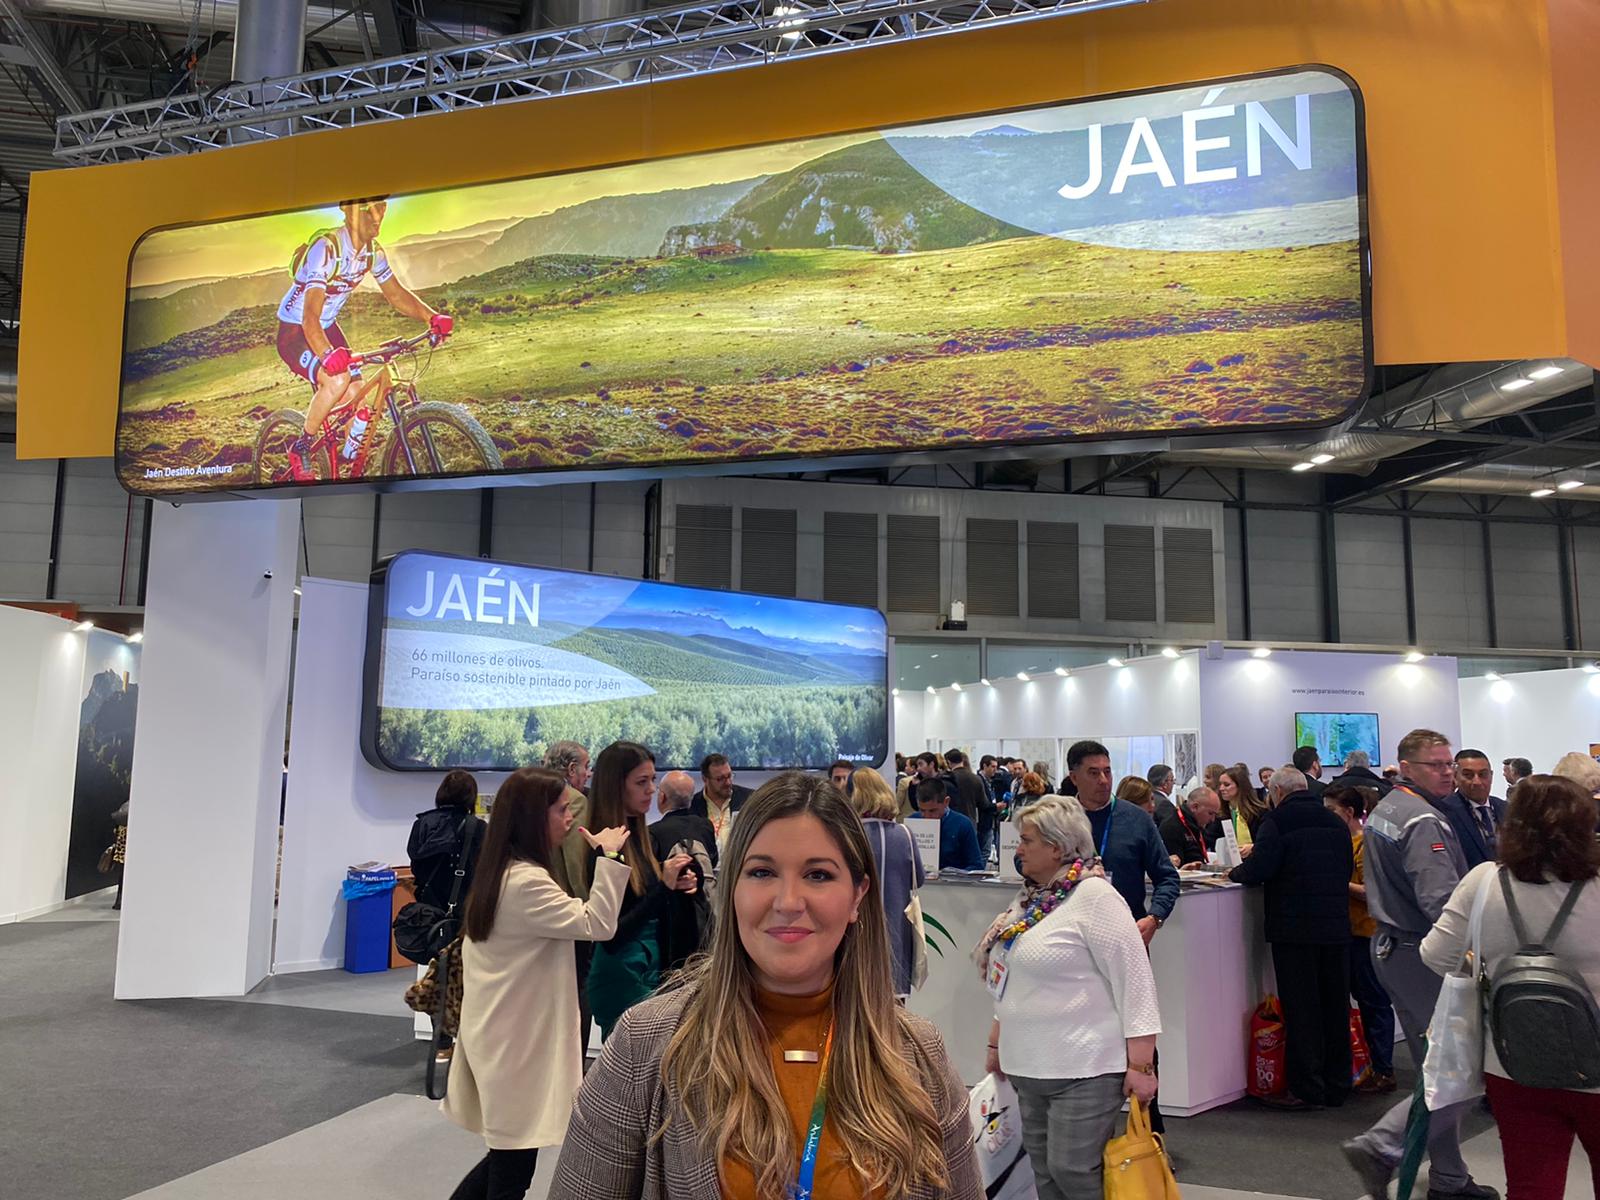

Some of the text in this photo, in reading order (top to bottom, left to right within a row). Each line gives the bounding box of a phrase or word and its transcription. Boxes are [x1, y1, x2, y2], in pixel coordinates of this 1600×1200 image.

[1057, 87, 1312, 200] JAÉN
[144, 464, 233, 479] Jaén Destino Aventura
[406, 567, 541, 627] JAÉN
[412, 649, 544, 669] 66 millones de olivos.
[411, 667, 621, 691] Paraíso sostenible pintado por Jaén
